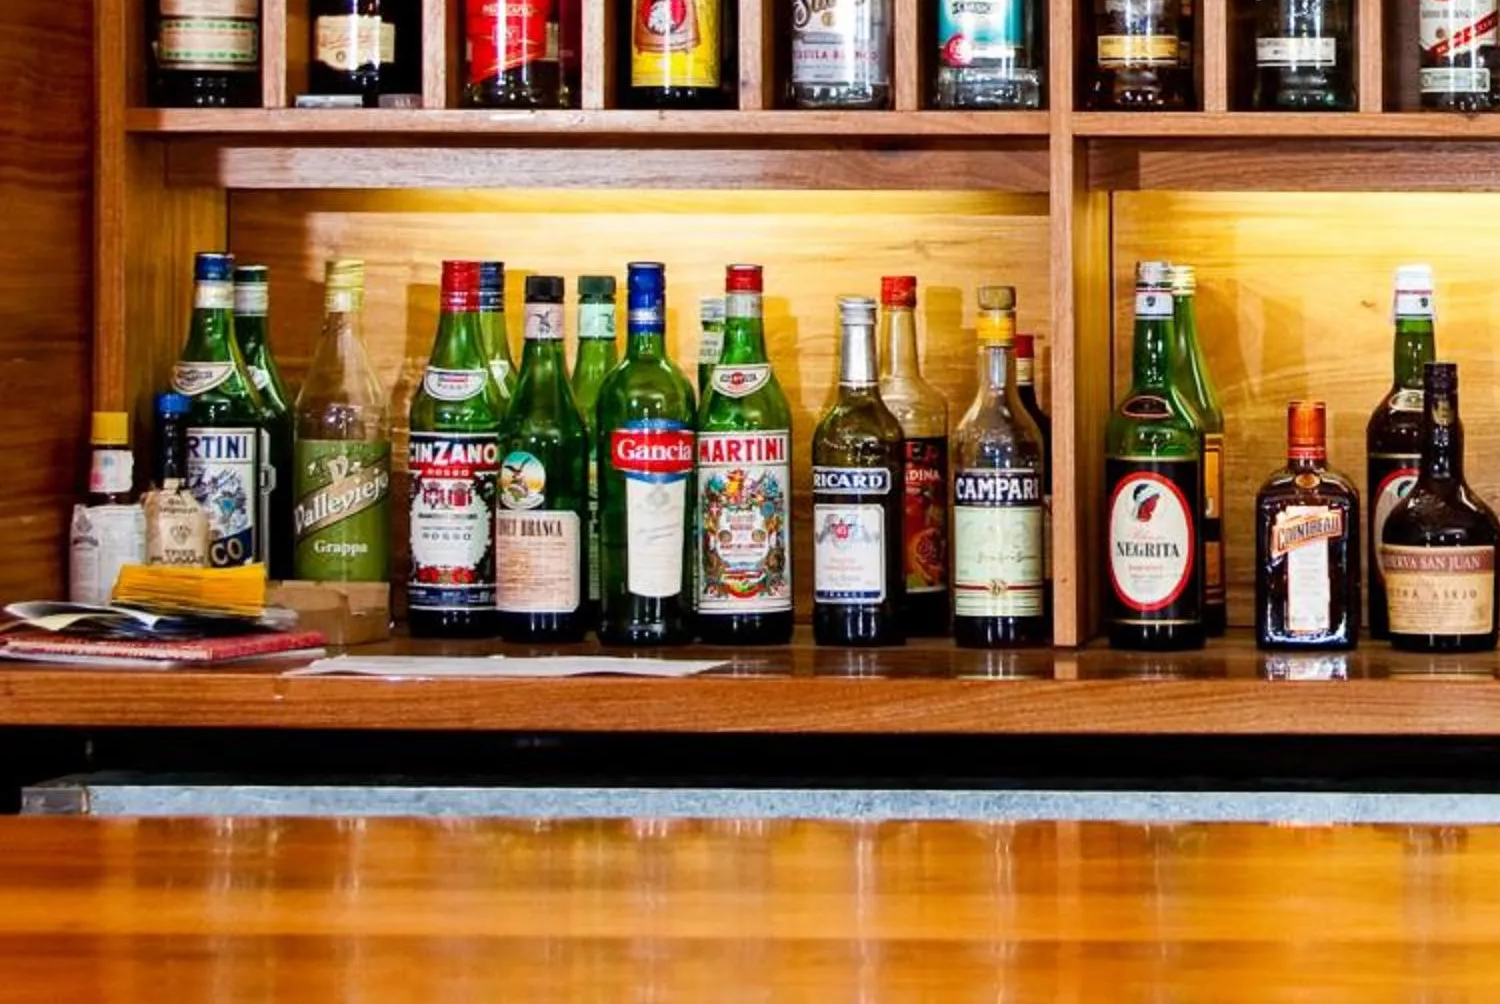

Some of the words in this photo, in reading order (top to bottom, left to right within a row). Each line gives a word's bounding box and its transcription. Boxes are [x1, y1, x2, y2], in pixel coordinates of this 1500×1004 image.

[186, 436, 247, 459] RTINI
[409, 441, 498, 466] CINZANO
[617, 438, 692, 461] Gancia
[699, 435, 784, 462] MARTINI
[813, 471, 883, 489] RICARD
[955, 477, 1038, 502] CAMPARI
[313, 539, 369, 557] Grappa
[1116, 541, 1180, 559] NEGRITA
[1420, 555, 1445, 569] SAN
[1448, 555, 1481, 570] JUAN
